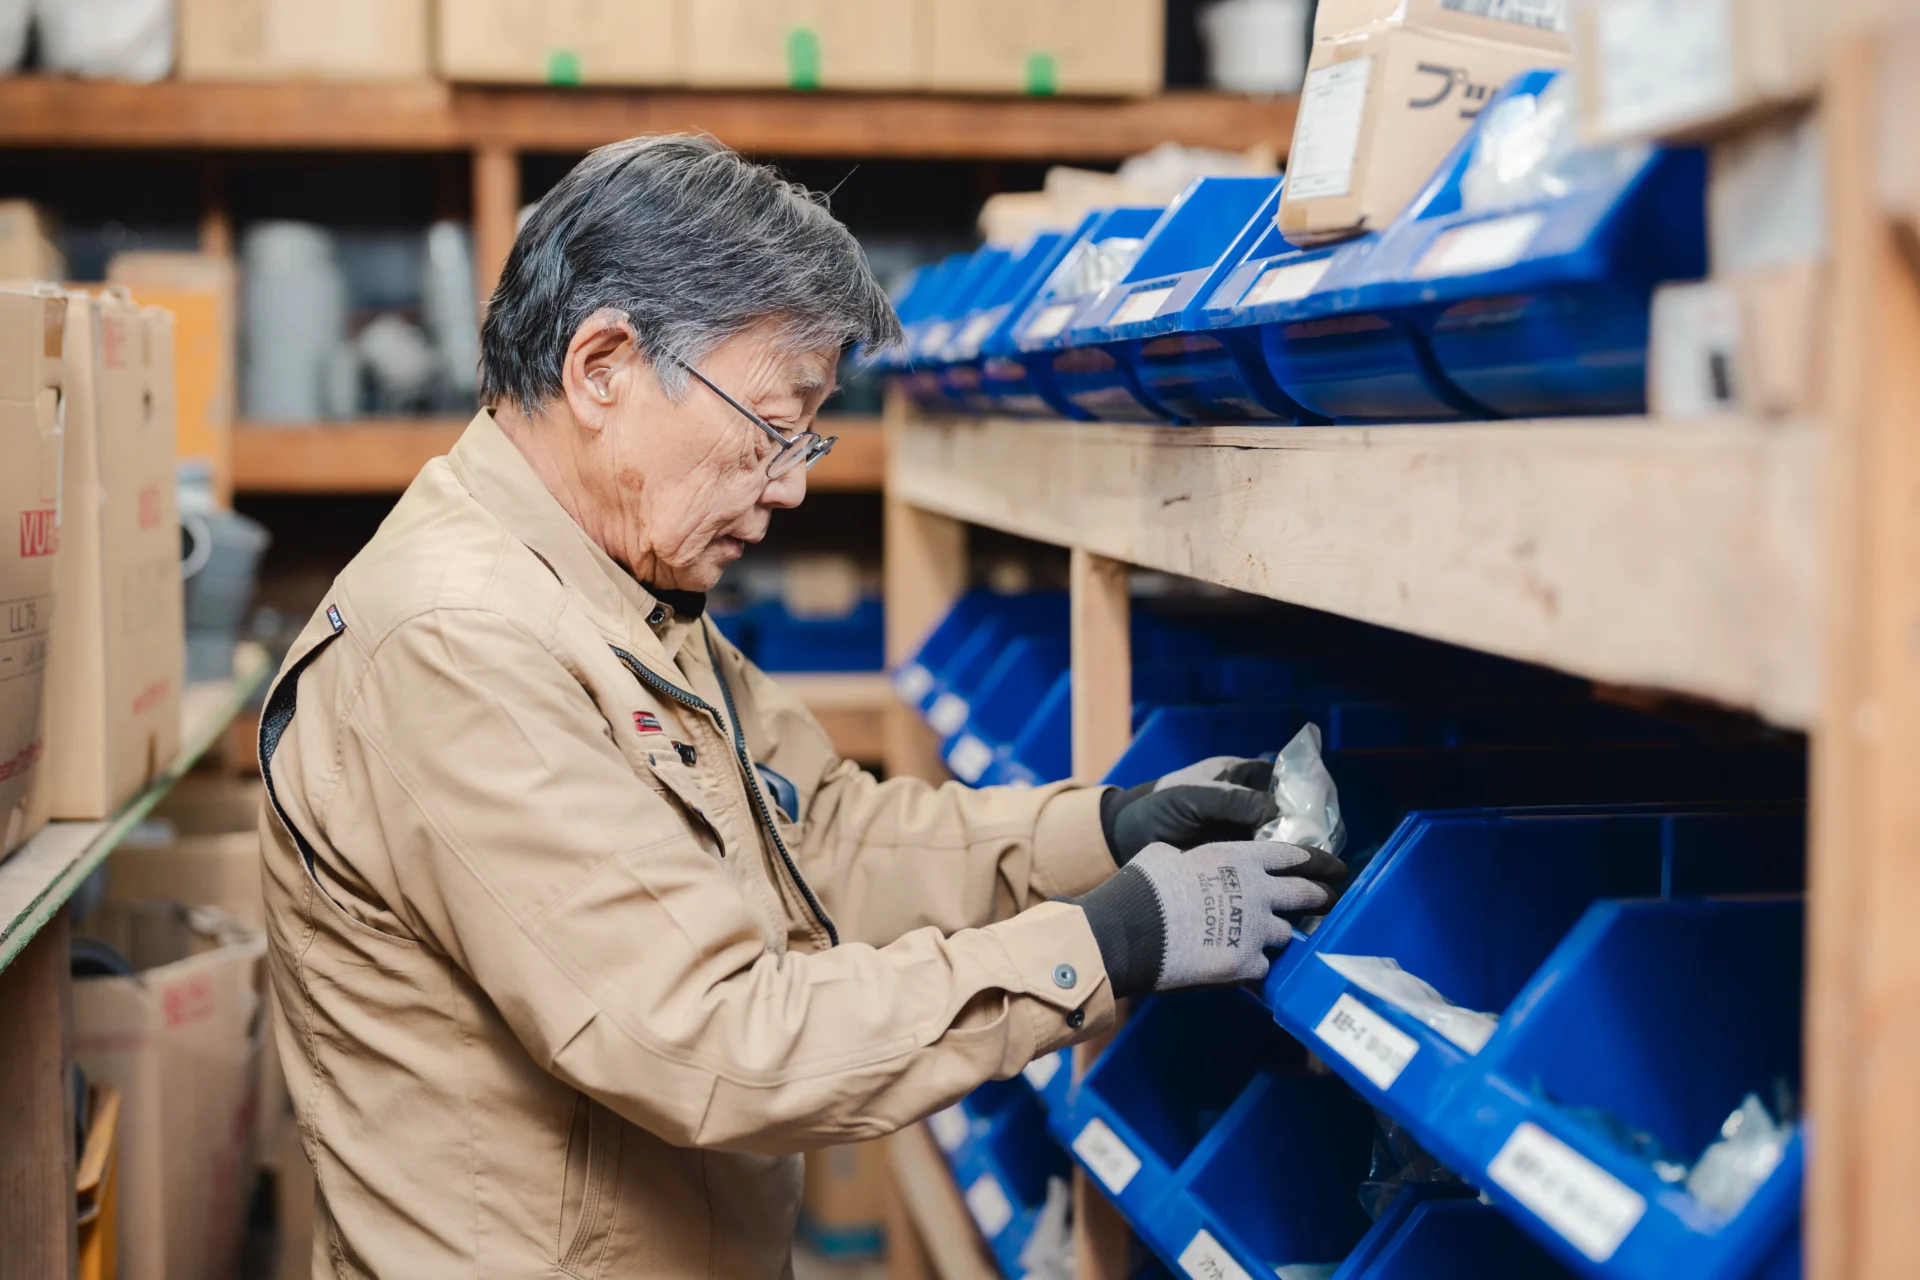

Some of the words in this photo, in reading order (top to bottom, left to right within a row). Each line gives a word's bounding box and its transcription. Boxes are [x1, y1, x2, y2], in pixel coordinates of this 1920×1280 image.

[1197, 873, 1209, 893] SIZE
[1204, 896, 1215, 946] GLOVE
[1227, 895, 1242, 948] LATEX
